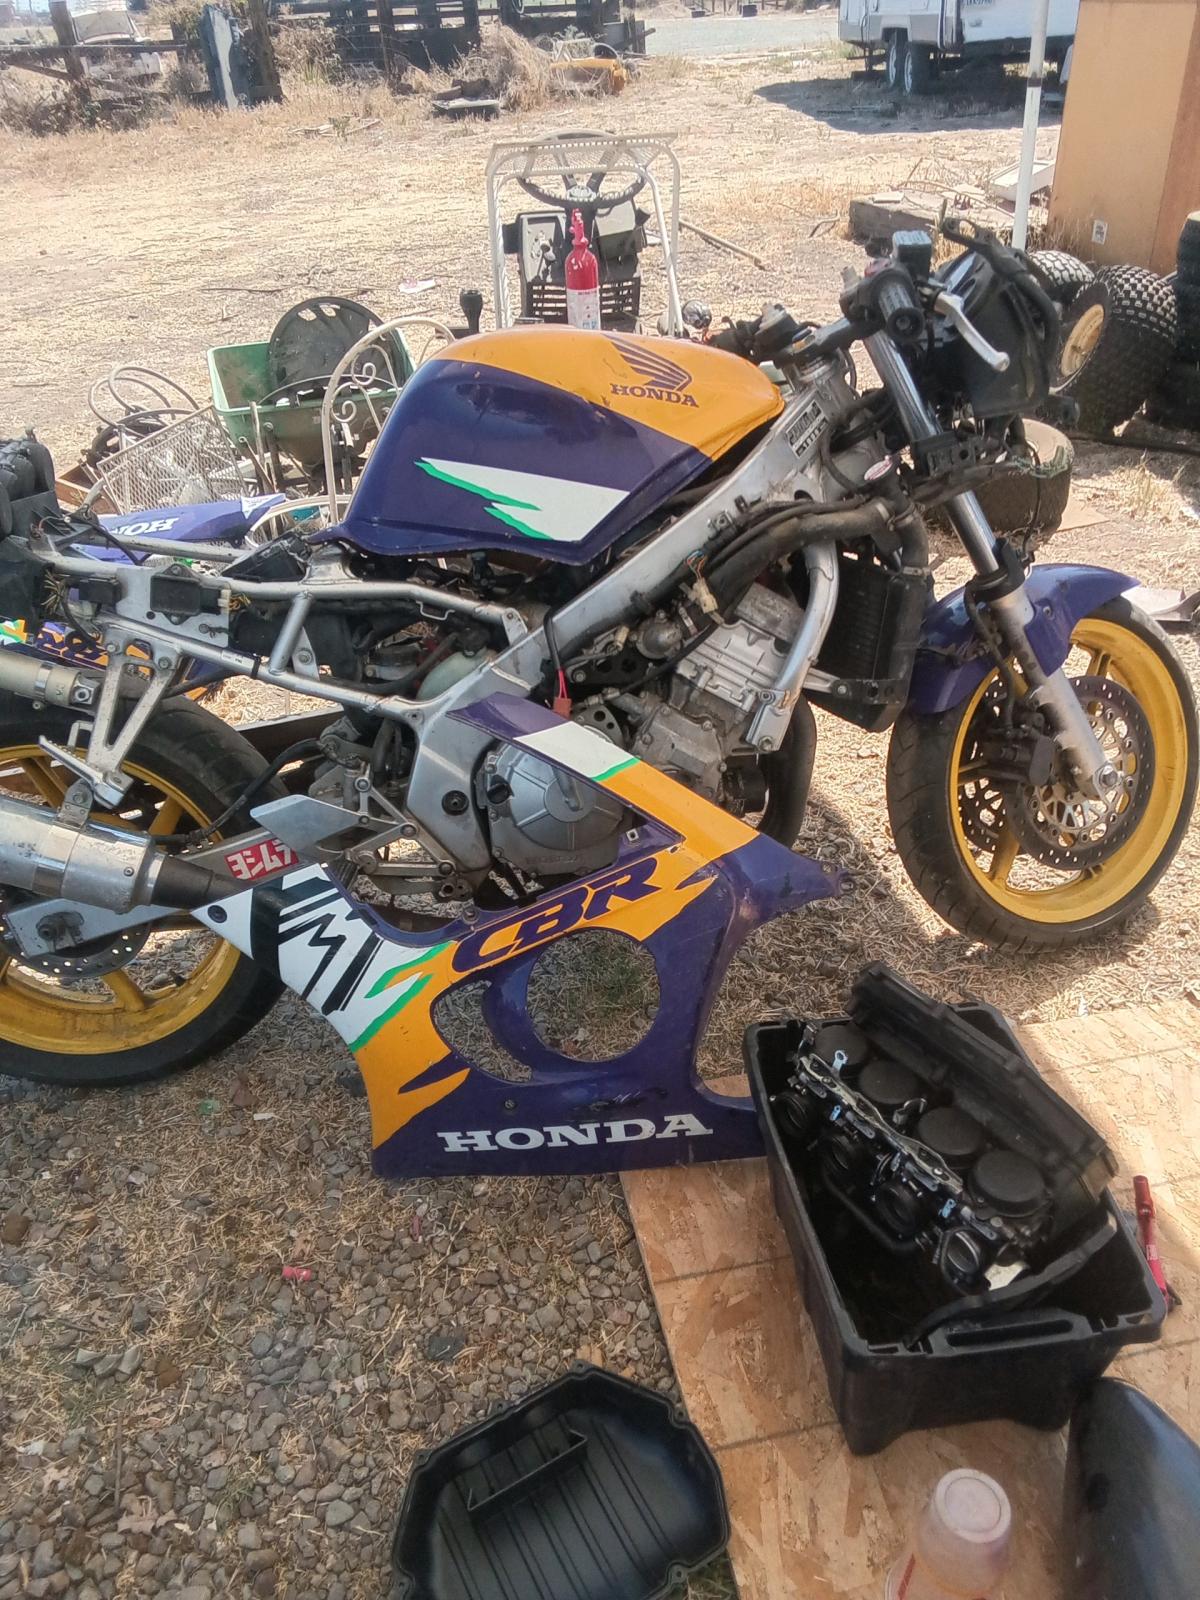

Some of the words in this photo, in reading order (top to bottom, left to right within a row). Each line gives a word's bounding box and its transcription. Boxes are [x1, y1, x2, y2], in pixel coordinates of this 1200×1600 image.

[610, 383, 699, 408] HONDA
[227, 839, 292, 880] ヨシムラ
[452, 857, 662, 972] CBR
[437, 1113, 713, 1152] HONDA
